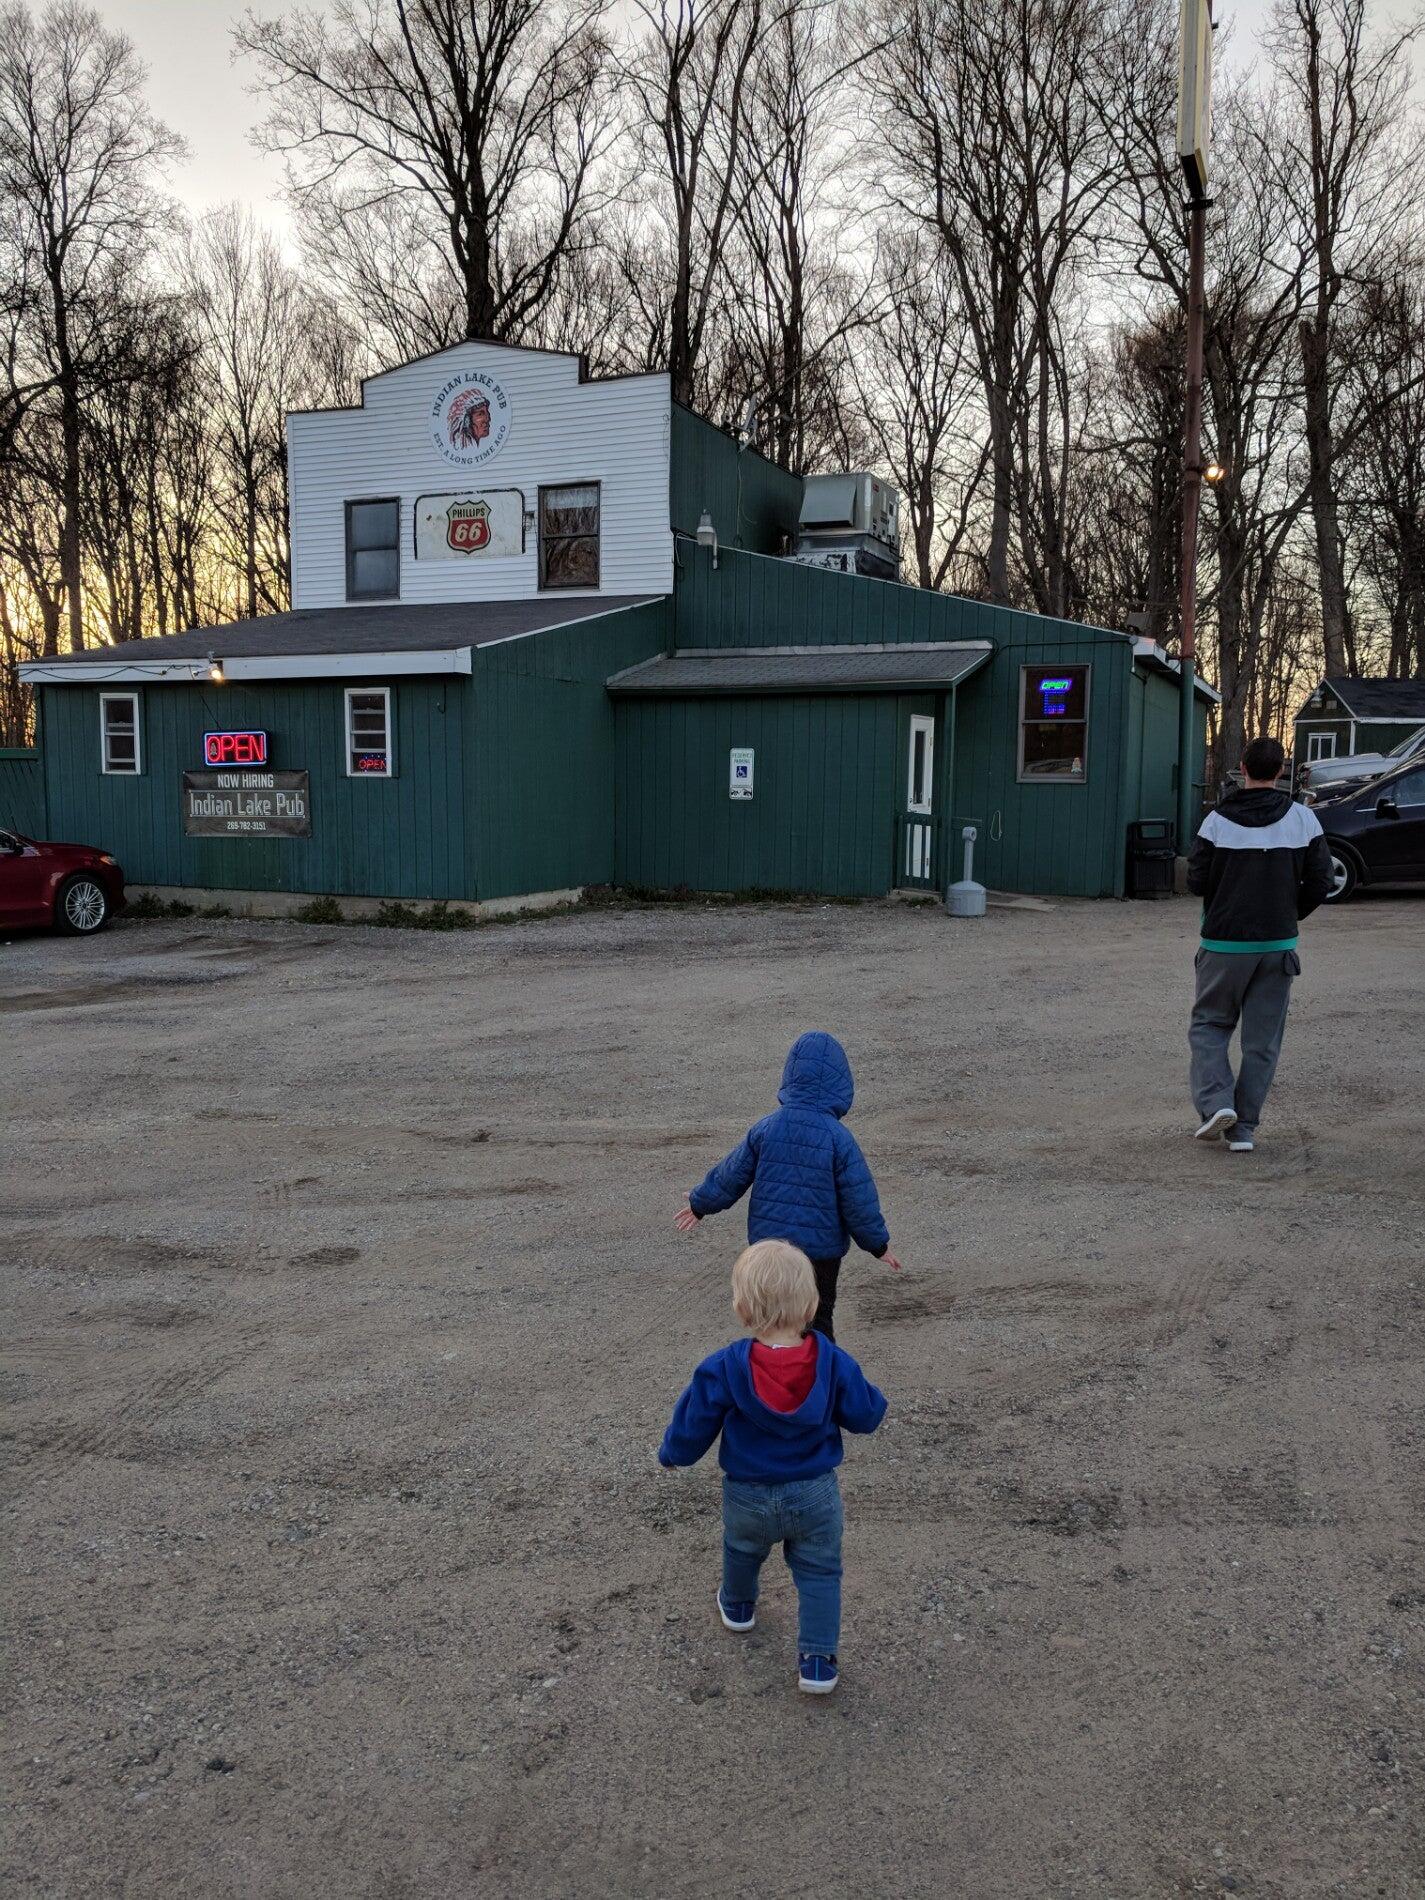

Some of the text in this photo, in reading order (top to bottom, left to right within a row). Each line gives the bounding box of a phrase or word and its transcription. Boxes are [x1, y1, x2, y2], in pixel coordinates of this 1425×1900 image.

[432, 373, 507, 417] INDIAN LAKE PUB
[449, 454, 473, 465] LONG
[474, 445, 496, 463] TIME
[495, 425, 506, 447] AGO
[452, 507, 486, 518] PHILLIPS
[455, 522, 483, 543] 66
[207, 735, 264, 762] OPEN
[359, 759, 387, 770] OPEN
[217, 774, 274, 788] NOW HIRING
[190, 793, 305, 816] Indian Lake Pub
